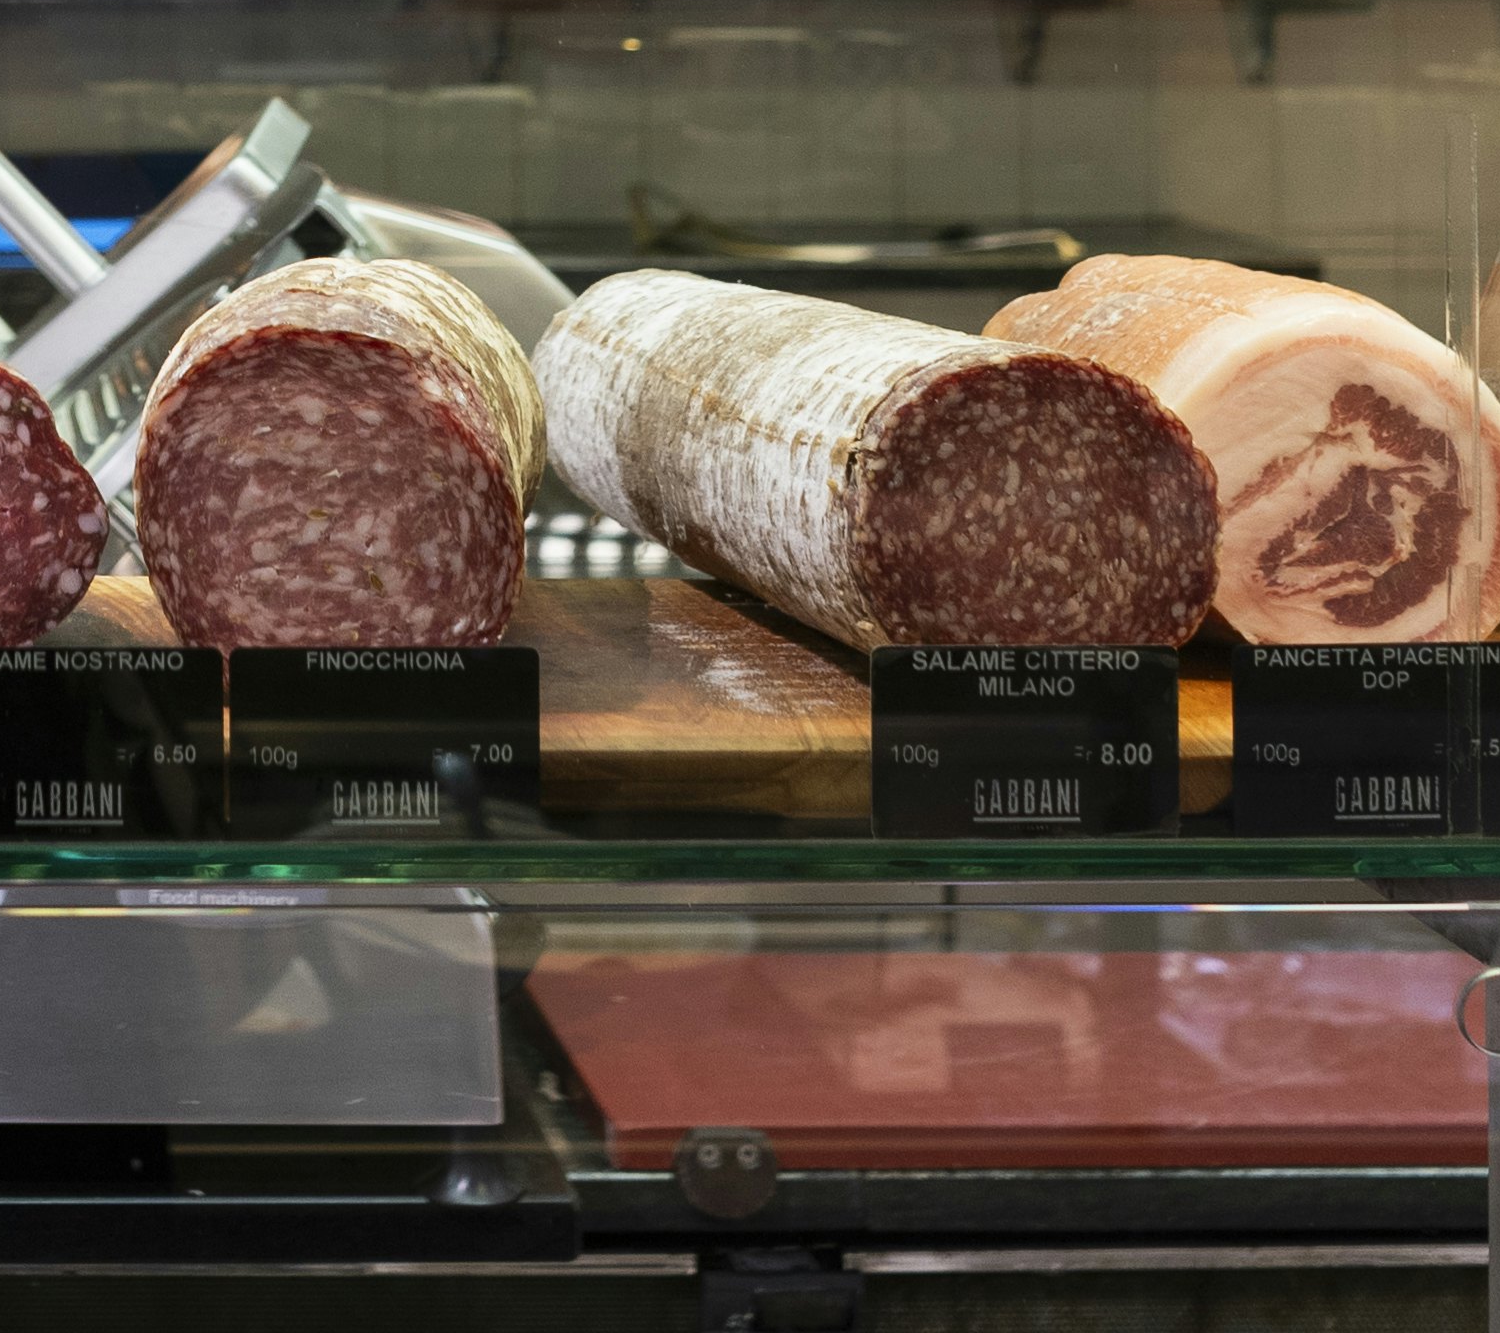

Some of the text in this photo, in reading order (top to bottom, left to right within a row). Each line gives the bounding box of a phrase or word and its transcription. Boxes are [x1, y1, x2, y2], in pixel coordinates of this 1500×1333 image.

[54, 651, 184, 671] NOSTRANO
[305, 650, 465, 671] FINOCCHIONA
[911, 650, 1140, 671] SALAME CITTERIO
[1253, 647, 1375, 668] PANCETTA
[978, 676, 1076, 697] MILANO
[1362, 670, 1410, 690] DOP
[153, 745, 197, 764] 6.50
[250, 746, 298, 770] 100g
[469, 744, 513, 764] 7.00
[890, 744, 940, 768] 100g
[1101, 743, 1153, 765] 8.00
[1252, 743, 1300, 766] 100g
[15, 780, 123, 819] GABBANI
[332, 781, 439, 818] GABBANI
[974, 779, 1080, 816] GABBANI
[1335, 775, 1440, 813] GABBANI
